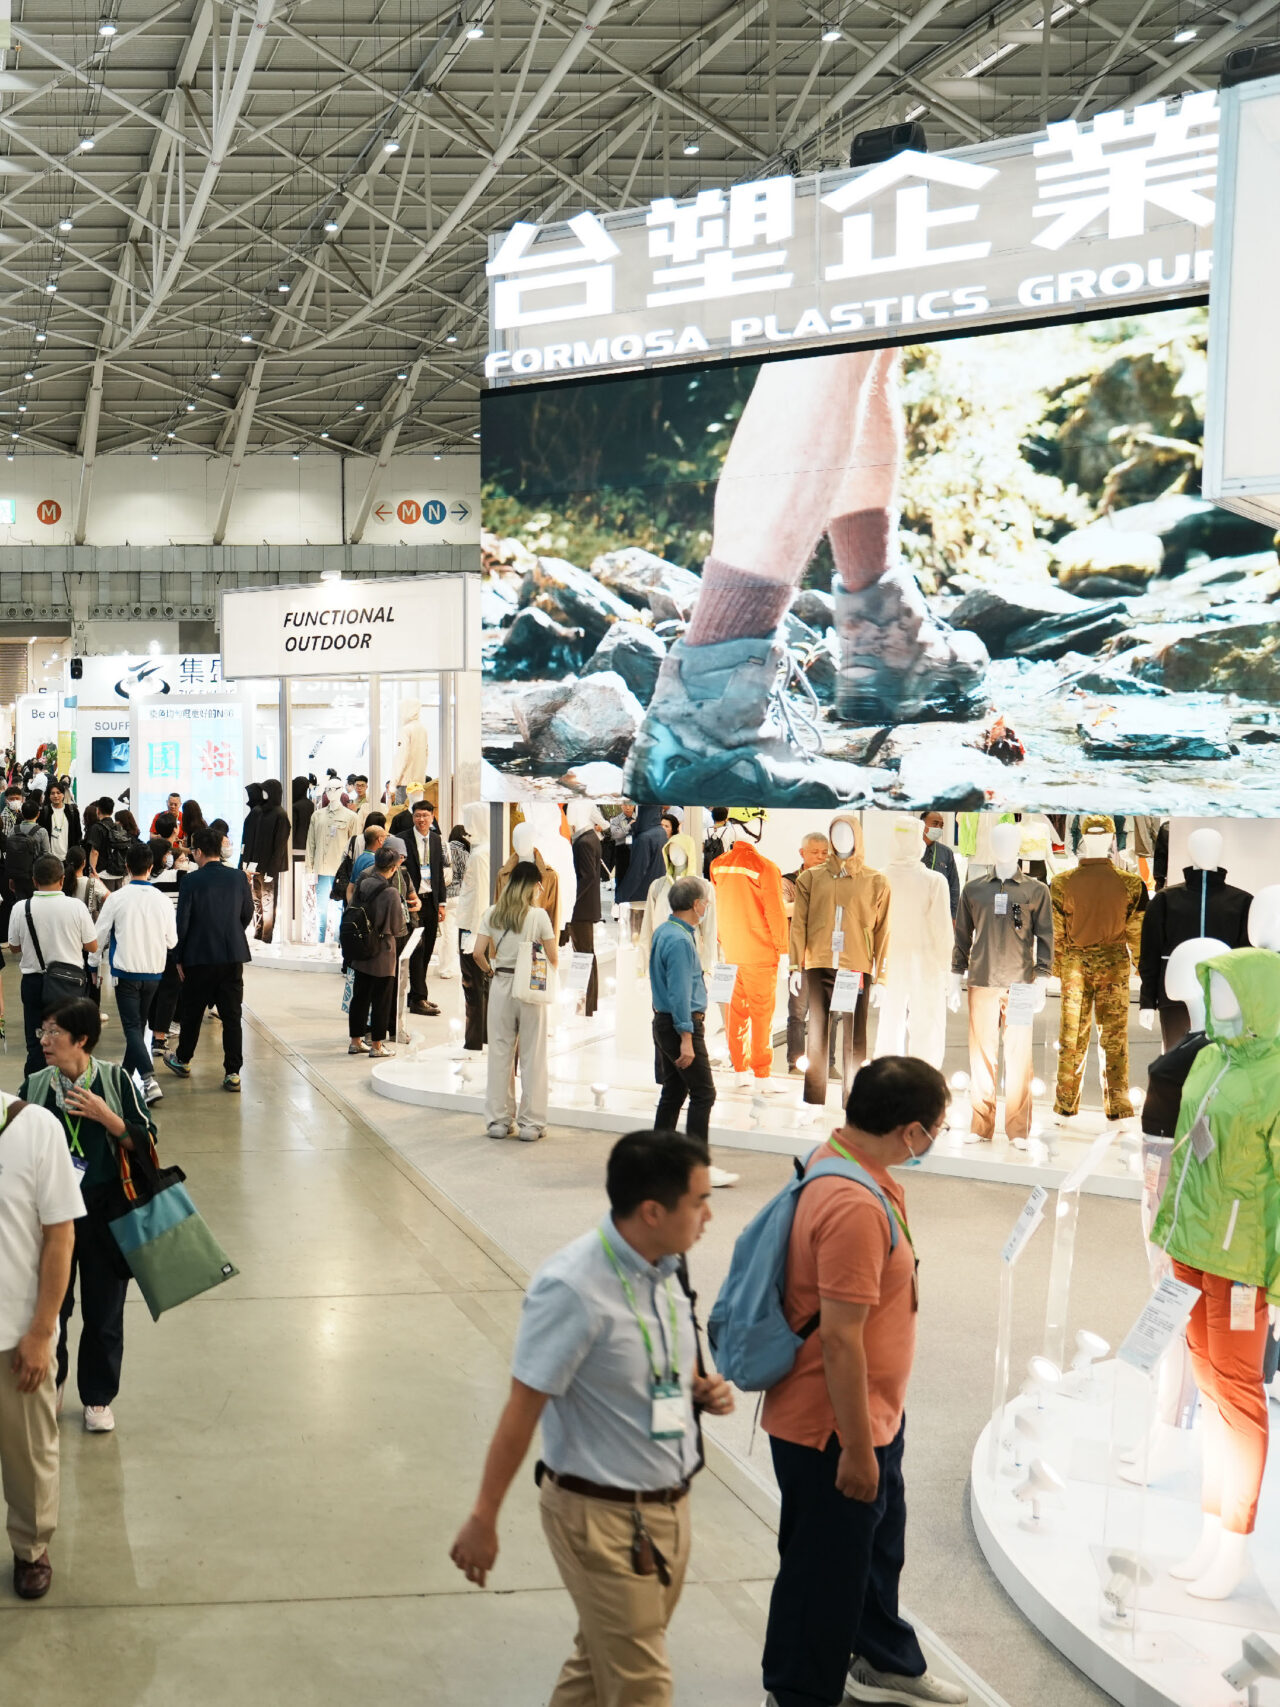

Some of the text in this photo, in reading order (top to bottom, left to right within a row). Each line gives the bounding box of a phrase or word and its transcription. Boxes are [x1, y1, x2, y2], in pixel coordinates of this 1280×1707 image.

[485, 90, 1221, 330] 台塑企業
[485, 325, 710, 378] FORMOSA
[730, 285, 989, 347] PLASTICS
[41, 503, 57, 521] M
[402, 503, 441, 521] M N
[283, 606, 395, 628] FUNCTIONAL
[285, 633, 372, 652] OUTDOOR
[31, 709, 46, 719] Be
